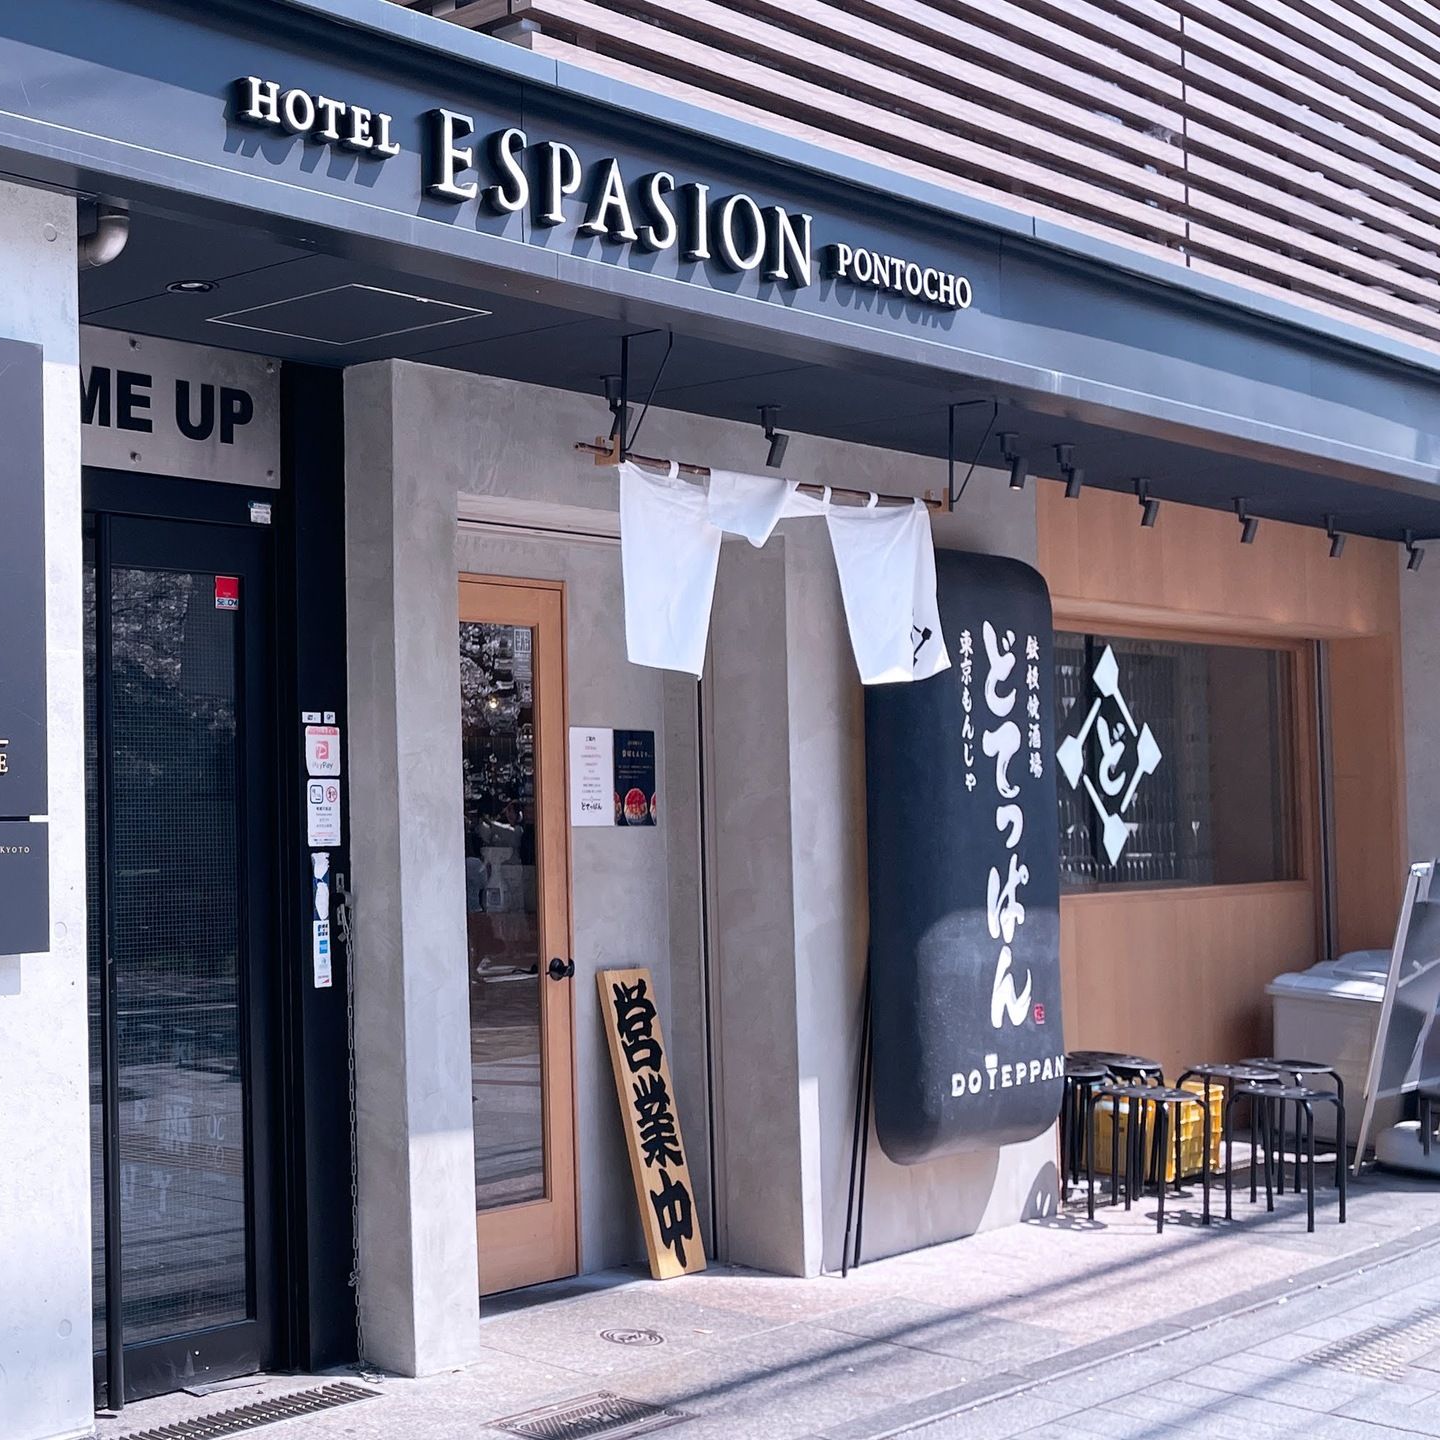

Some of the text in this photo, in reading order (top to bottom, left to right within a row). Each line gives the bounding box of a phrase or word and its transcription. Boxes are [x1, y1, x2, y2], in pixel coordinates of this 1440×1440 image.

[243, 76, 973, 309] HOTEL ESPASION PONTOCHO
[175, 379, 254, 444] UP
[959, 629, 977, 792] 東京もんじゃ
[0, 846, 30, 854] KYOTO
[982, 620, 1032, 1029] どてっぱん
[613, 978, 694, 1269] 営業中
[951, 1053, 1064, 1097] DOTEPPAN
